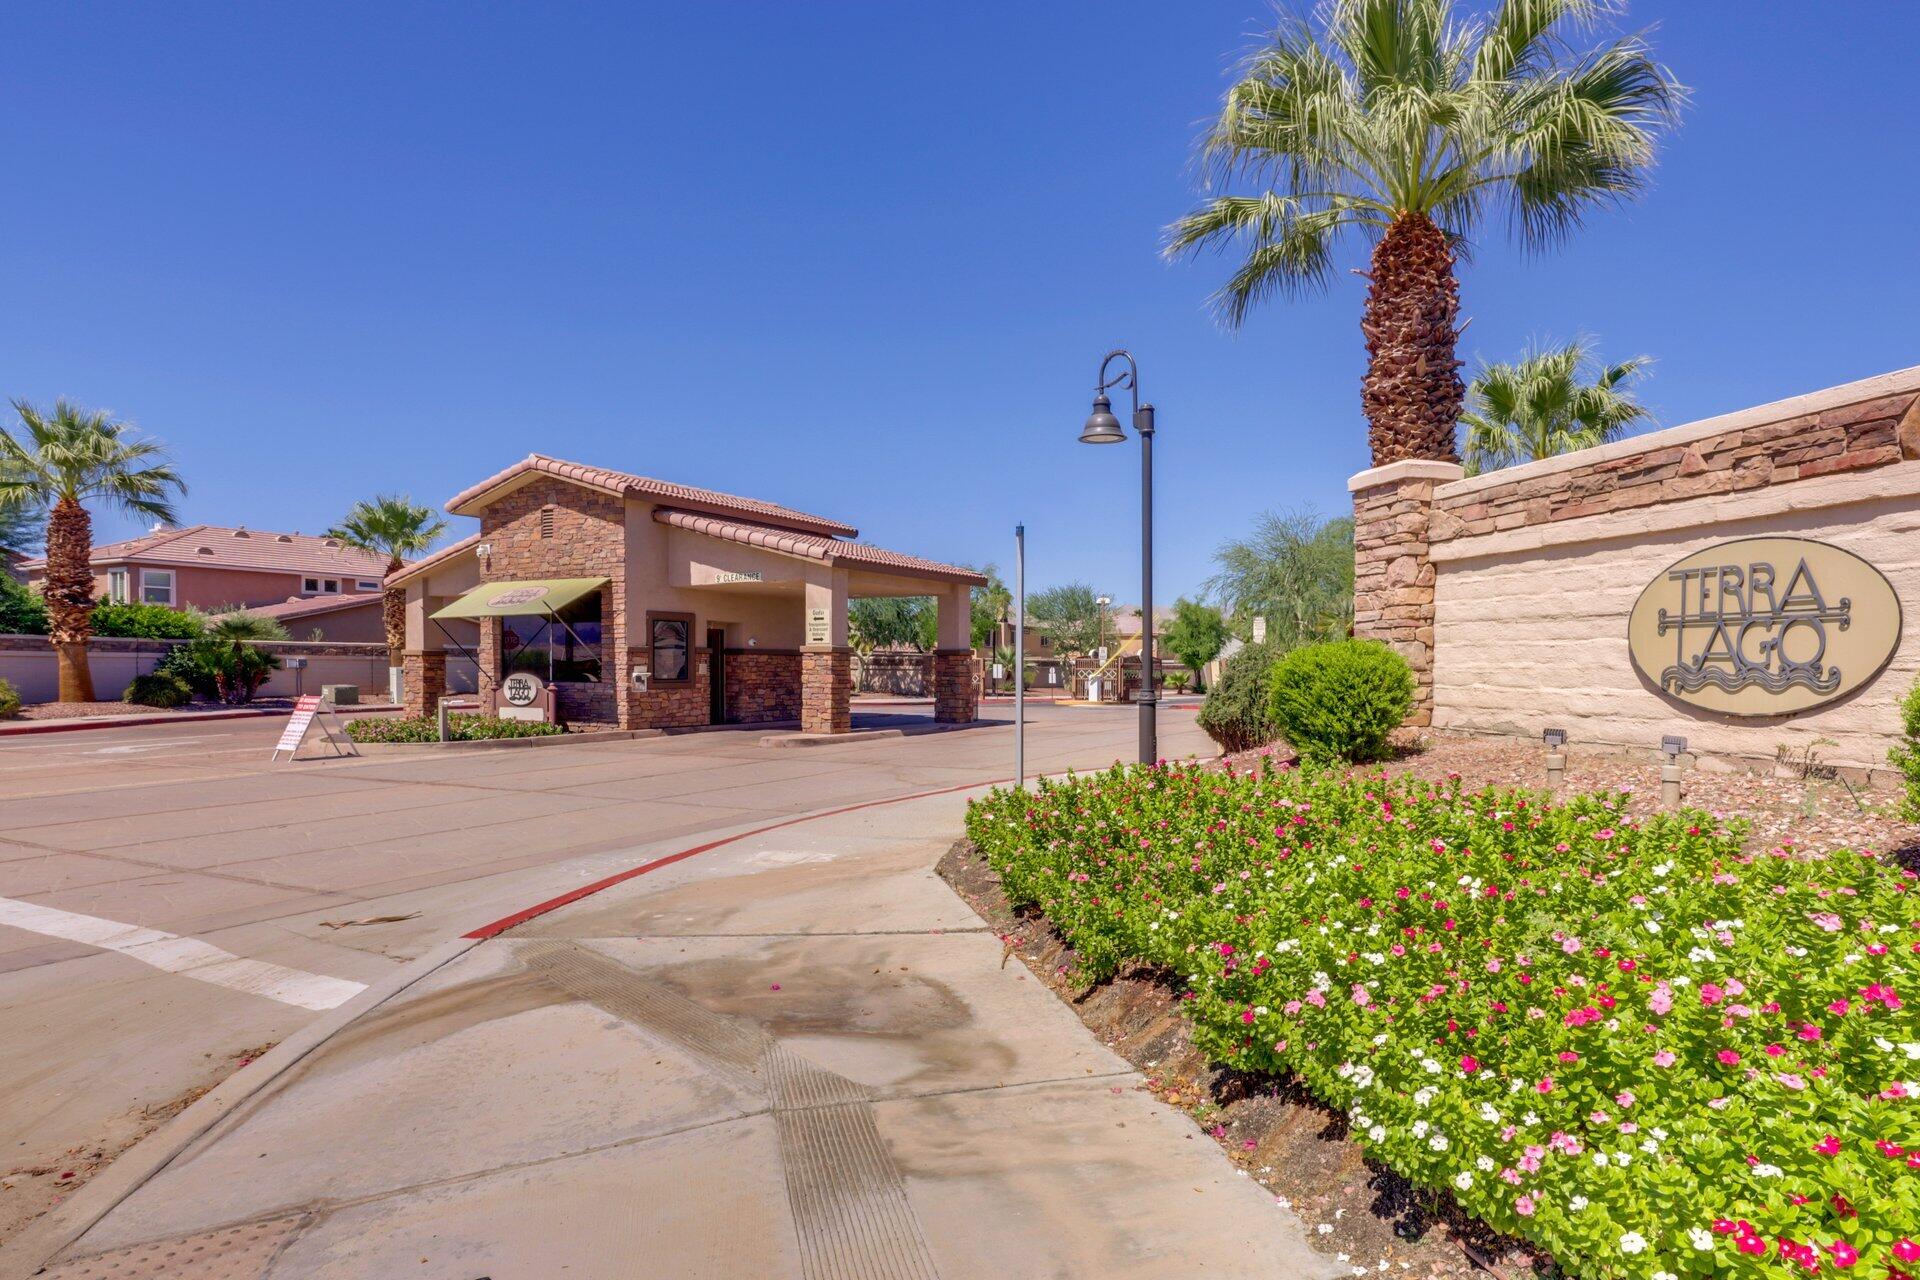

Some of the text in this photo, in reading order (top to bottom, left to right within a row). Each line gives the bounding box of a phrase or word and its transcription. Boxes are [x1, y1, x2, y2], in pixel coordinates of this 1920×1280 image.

[723, 572, 760, 583] CLEARANCE
[1669, 557, 1826, 620] TERRA
[1678, 616, 1826, 676] LAGO
[509, 678, 529, 688] TERRA
[510, 687, 530, 698] LAGO
